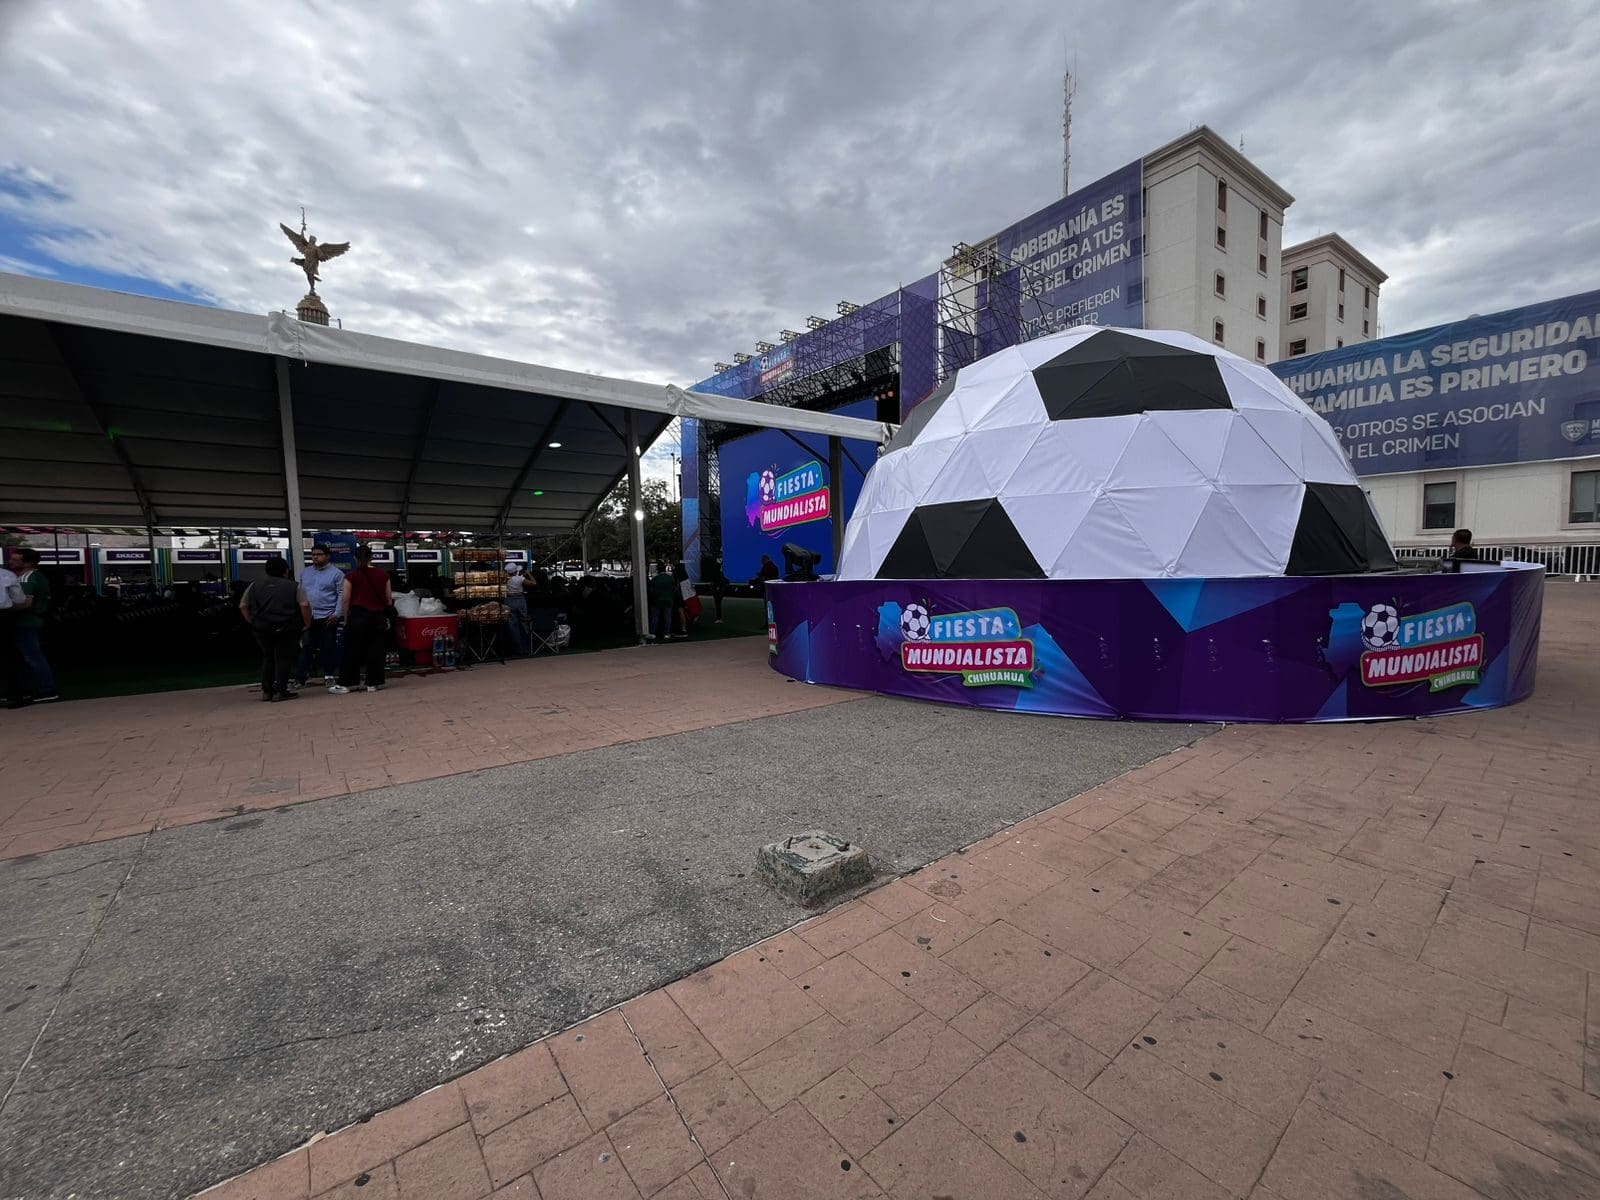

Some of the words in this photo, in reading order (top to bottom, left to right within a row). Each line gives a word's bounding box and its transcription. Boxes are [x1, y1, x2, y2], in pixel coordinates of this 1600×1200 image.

[1010, 206, 1098, 265] SOBERANÍA
[1102, 194, 1125, 222] ES
[1081, 237, 1092, 256] A
[1093, 221, 1124, 249] TUS
[1045, 270, 1070, 292] DEL
[1072, 240, 1131, 280] CRIMEN
[1056, 285, 1121, 321] PREFIEREN
[1393, 350, 1426, 375] LA
[1399, 375, 1434, 399] ES
[1440, 349, 1588, 396] PRIMERO
[1347, 417, 1406, 440] OTROS
[1415, 412, 1439, 431] SE
[1441, 397, 1546, 427] ASOCIAN
[1357, 443, 1379, 459] EL
[1382, 433, 1460, 456] CRIMEN
[777, 470, 815, 498] FIESTA
[763, 494, 827, 525] MUNDIALISTA
[934, 616, 1005, 639] FIESTA
[1404, 612, 1465, 644] FIESTA
[906, 647, 1028, 666] MUNDIALISTA
[1368, 643, 1479, 679] MUNDIALISTA
[967, 671, 1025, 684] CHIHUAHUA
[1433, 670, 1476, 689] CHIHUAHUA
